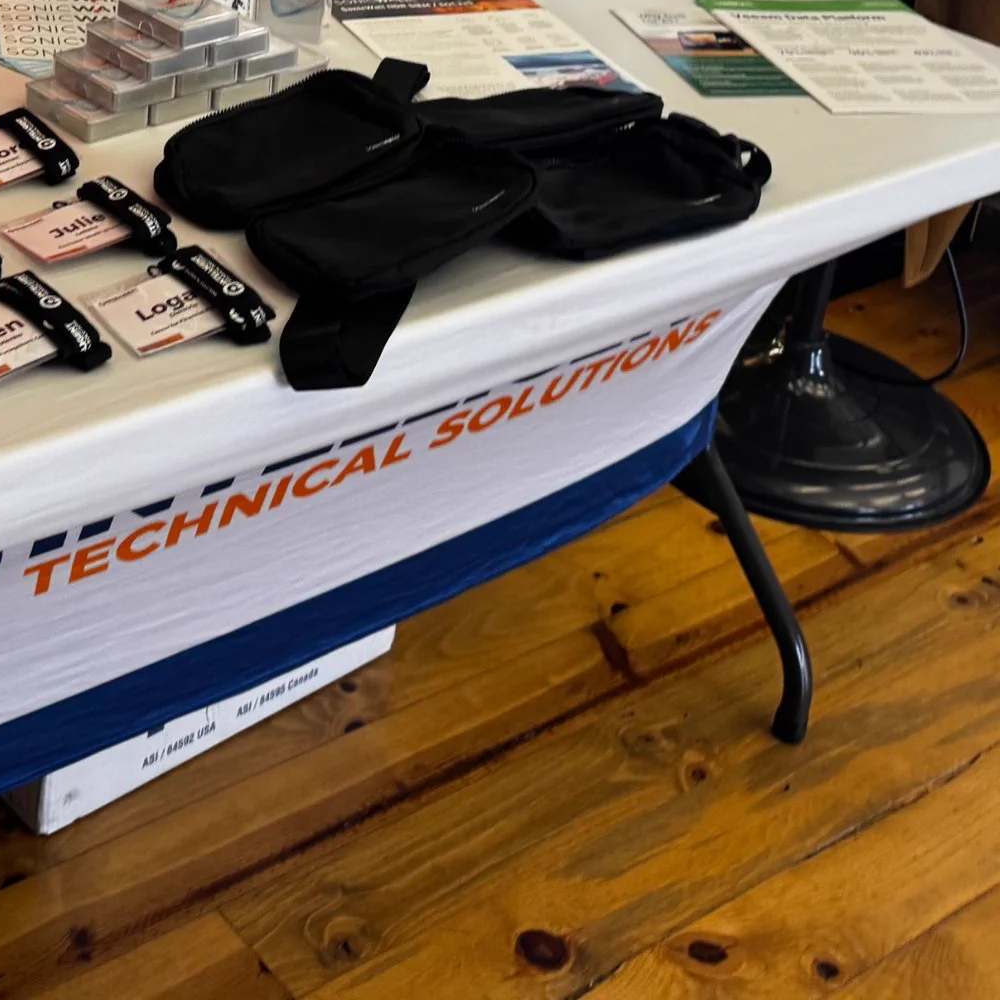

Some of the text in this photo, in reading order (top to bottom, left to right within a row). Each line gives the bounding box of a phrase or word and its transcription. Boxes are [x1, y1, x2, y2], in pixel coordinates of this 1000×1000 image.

[24, 309, 722, 597] TECHNICAL SOLUTIONS
[236, 700, 252, 718] ASI
[287, 667, 319, 692] Canada
[142, 751, 158, 770] ASI
[197, 721, 216, 740] USA
